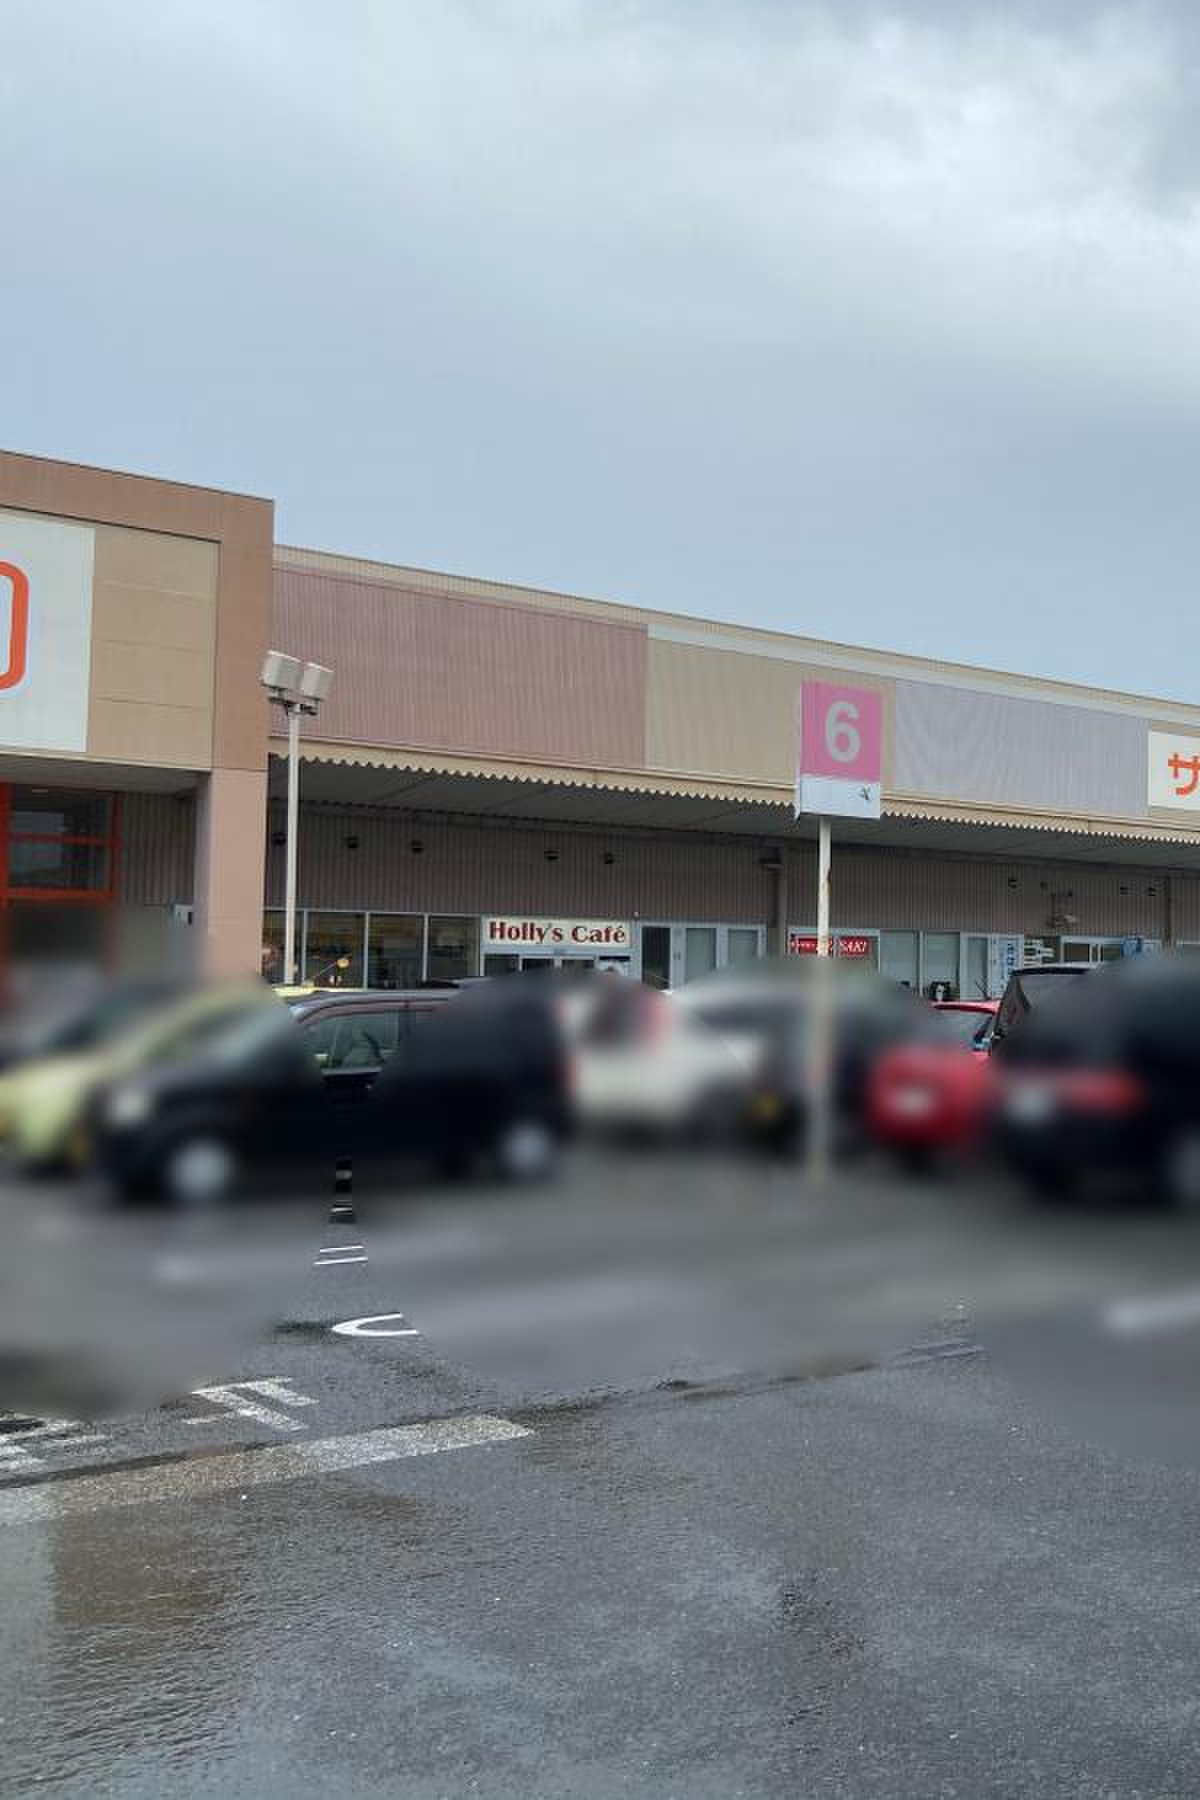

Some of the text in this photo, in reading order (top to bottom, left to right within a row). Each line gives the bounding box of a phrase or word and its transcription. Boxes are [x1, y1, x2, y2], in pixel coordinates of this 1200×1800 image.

[825, 700, 862, 765] 6
[489, 920, 626, 945] Holly's Café
